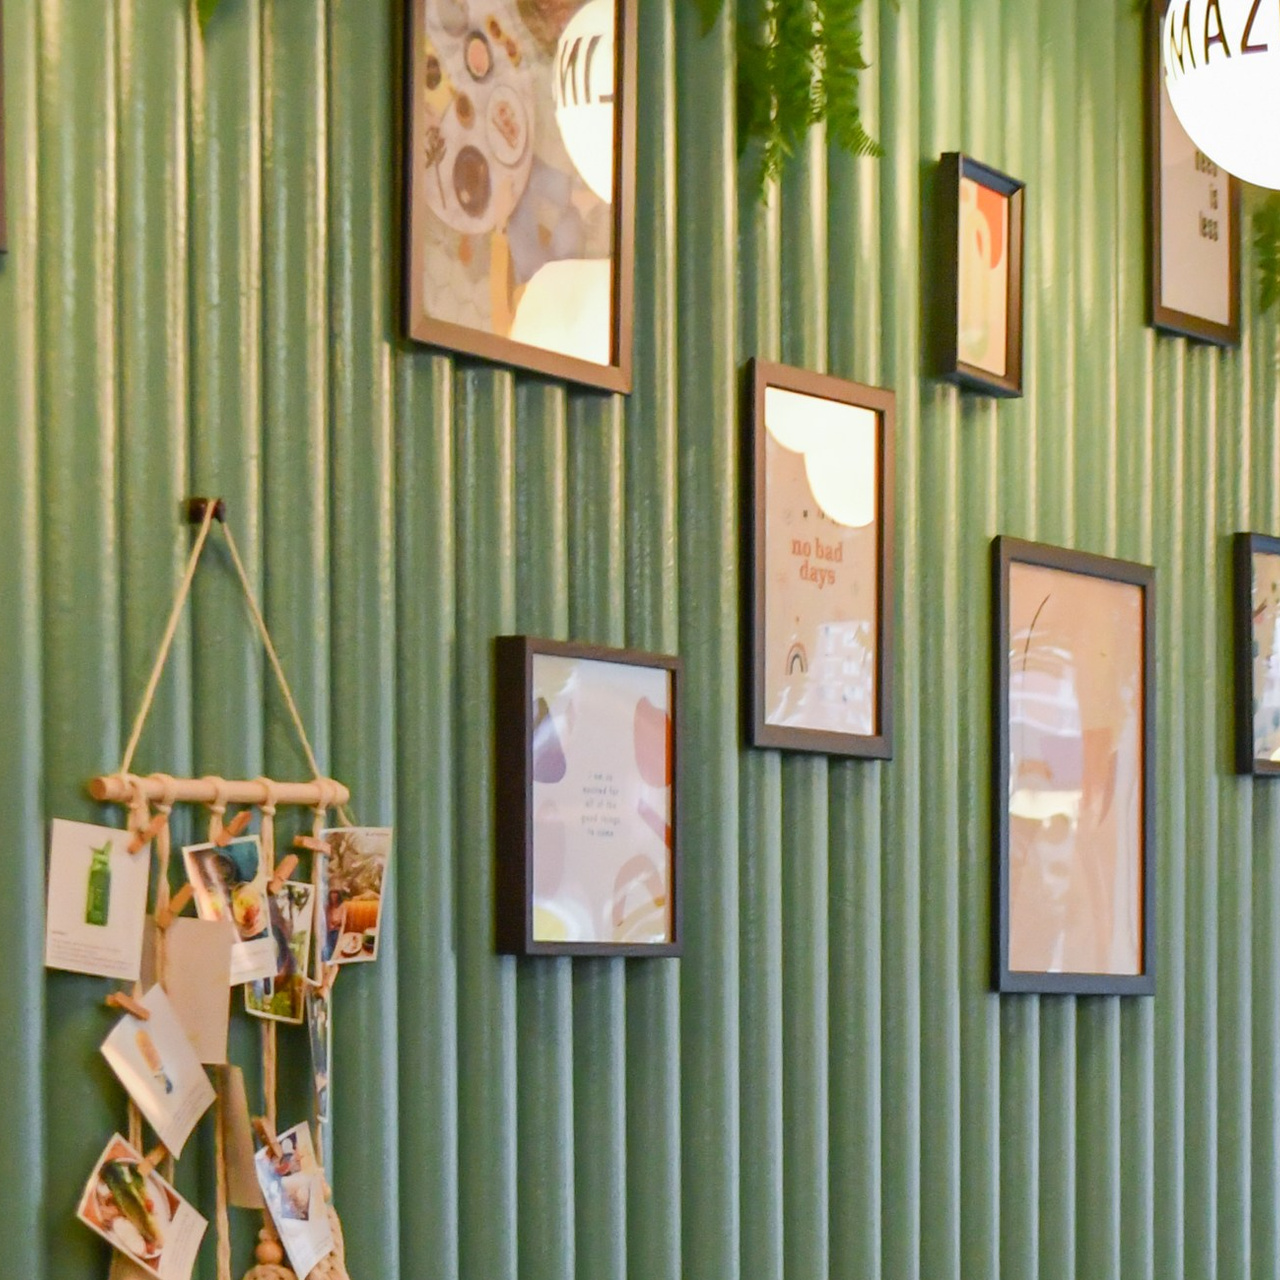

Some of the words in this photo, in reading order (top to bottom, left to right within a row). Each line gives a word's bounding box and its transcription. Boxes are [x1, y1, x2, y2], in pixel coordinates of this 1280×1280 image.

[791, 539, 811, 557] no
[815, 537, 843, 563] bad
[800, 560, 835, 589] days
